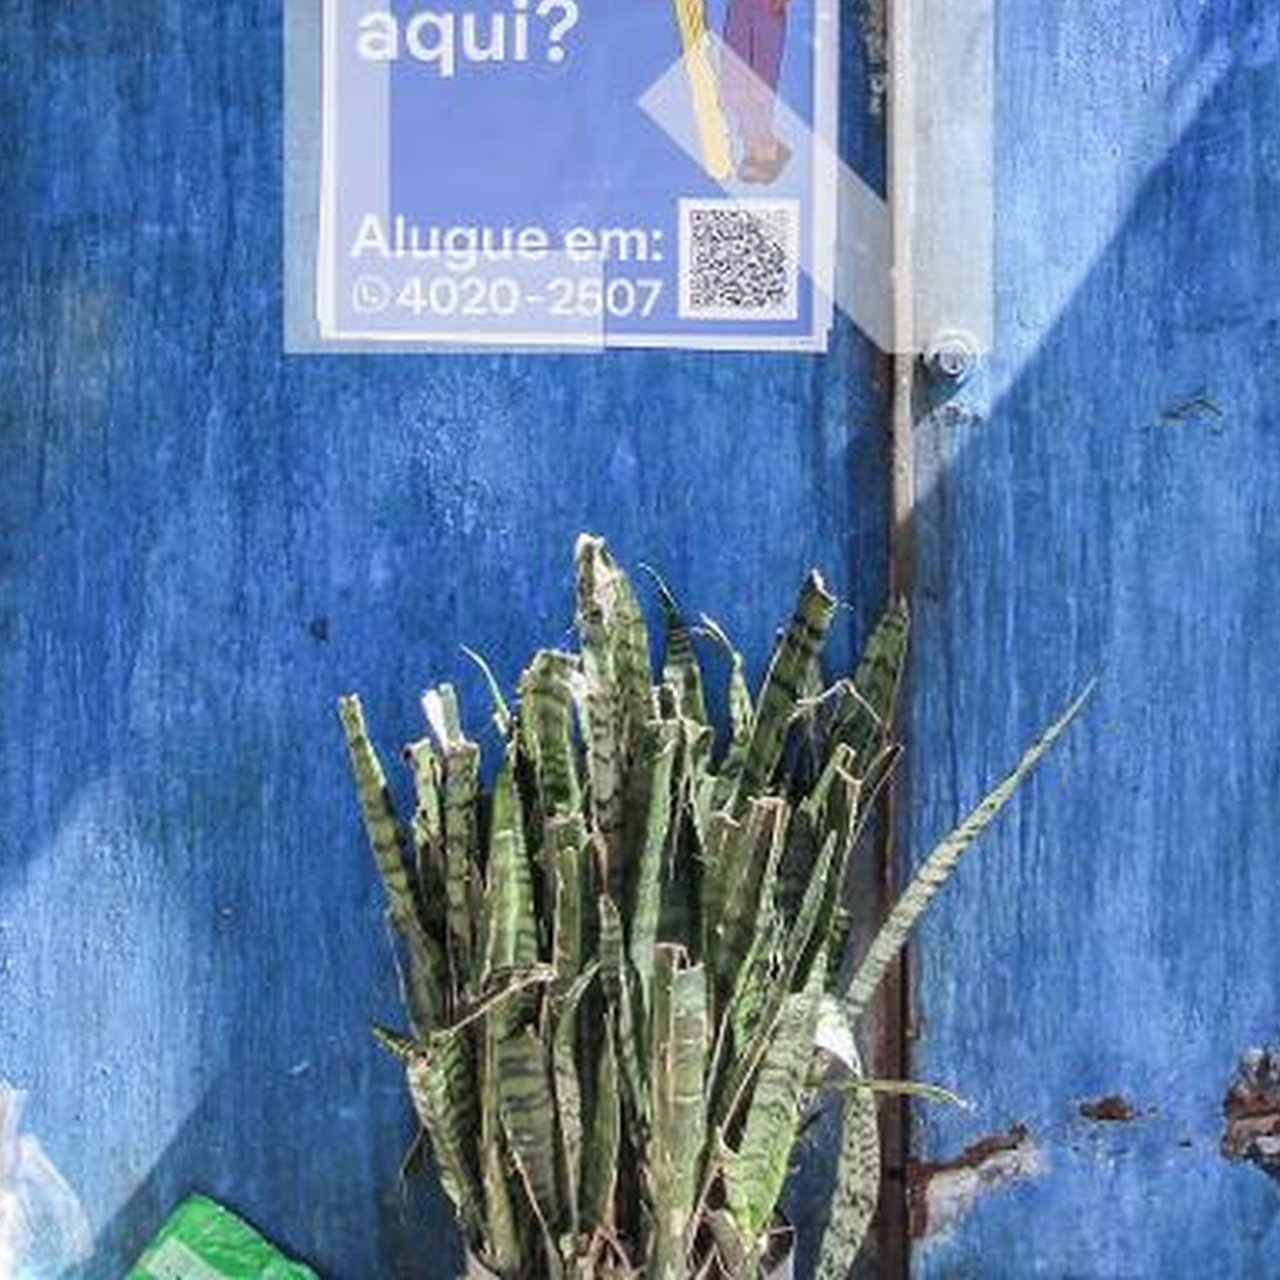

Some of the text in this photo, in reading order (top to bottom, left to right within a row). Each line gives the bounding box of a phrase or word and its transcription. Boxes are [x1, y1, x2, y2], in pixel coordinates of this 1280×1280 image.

[351, 214, 663, 271] Alugue em:
[397, 278, 663, 317] 4020-2507
